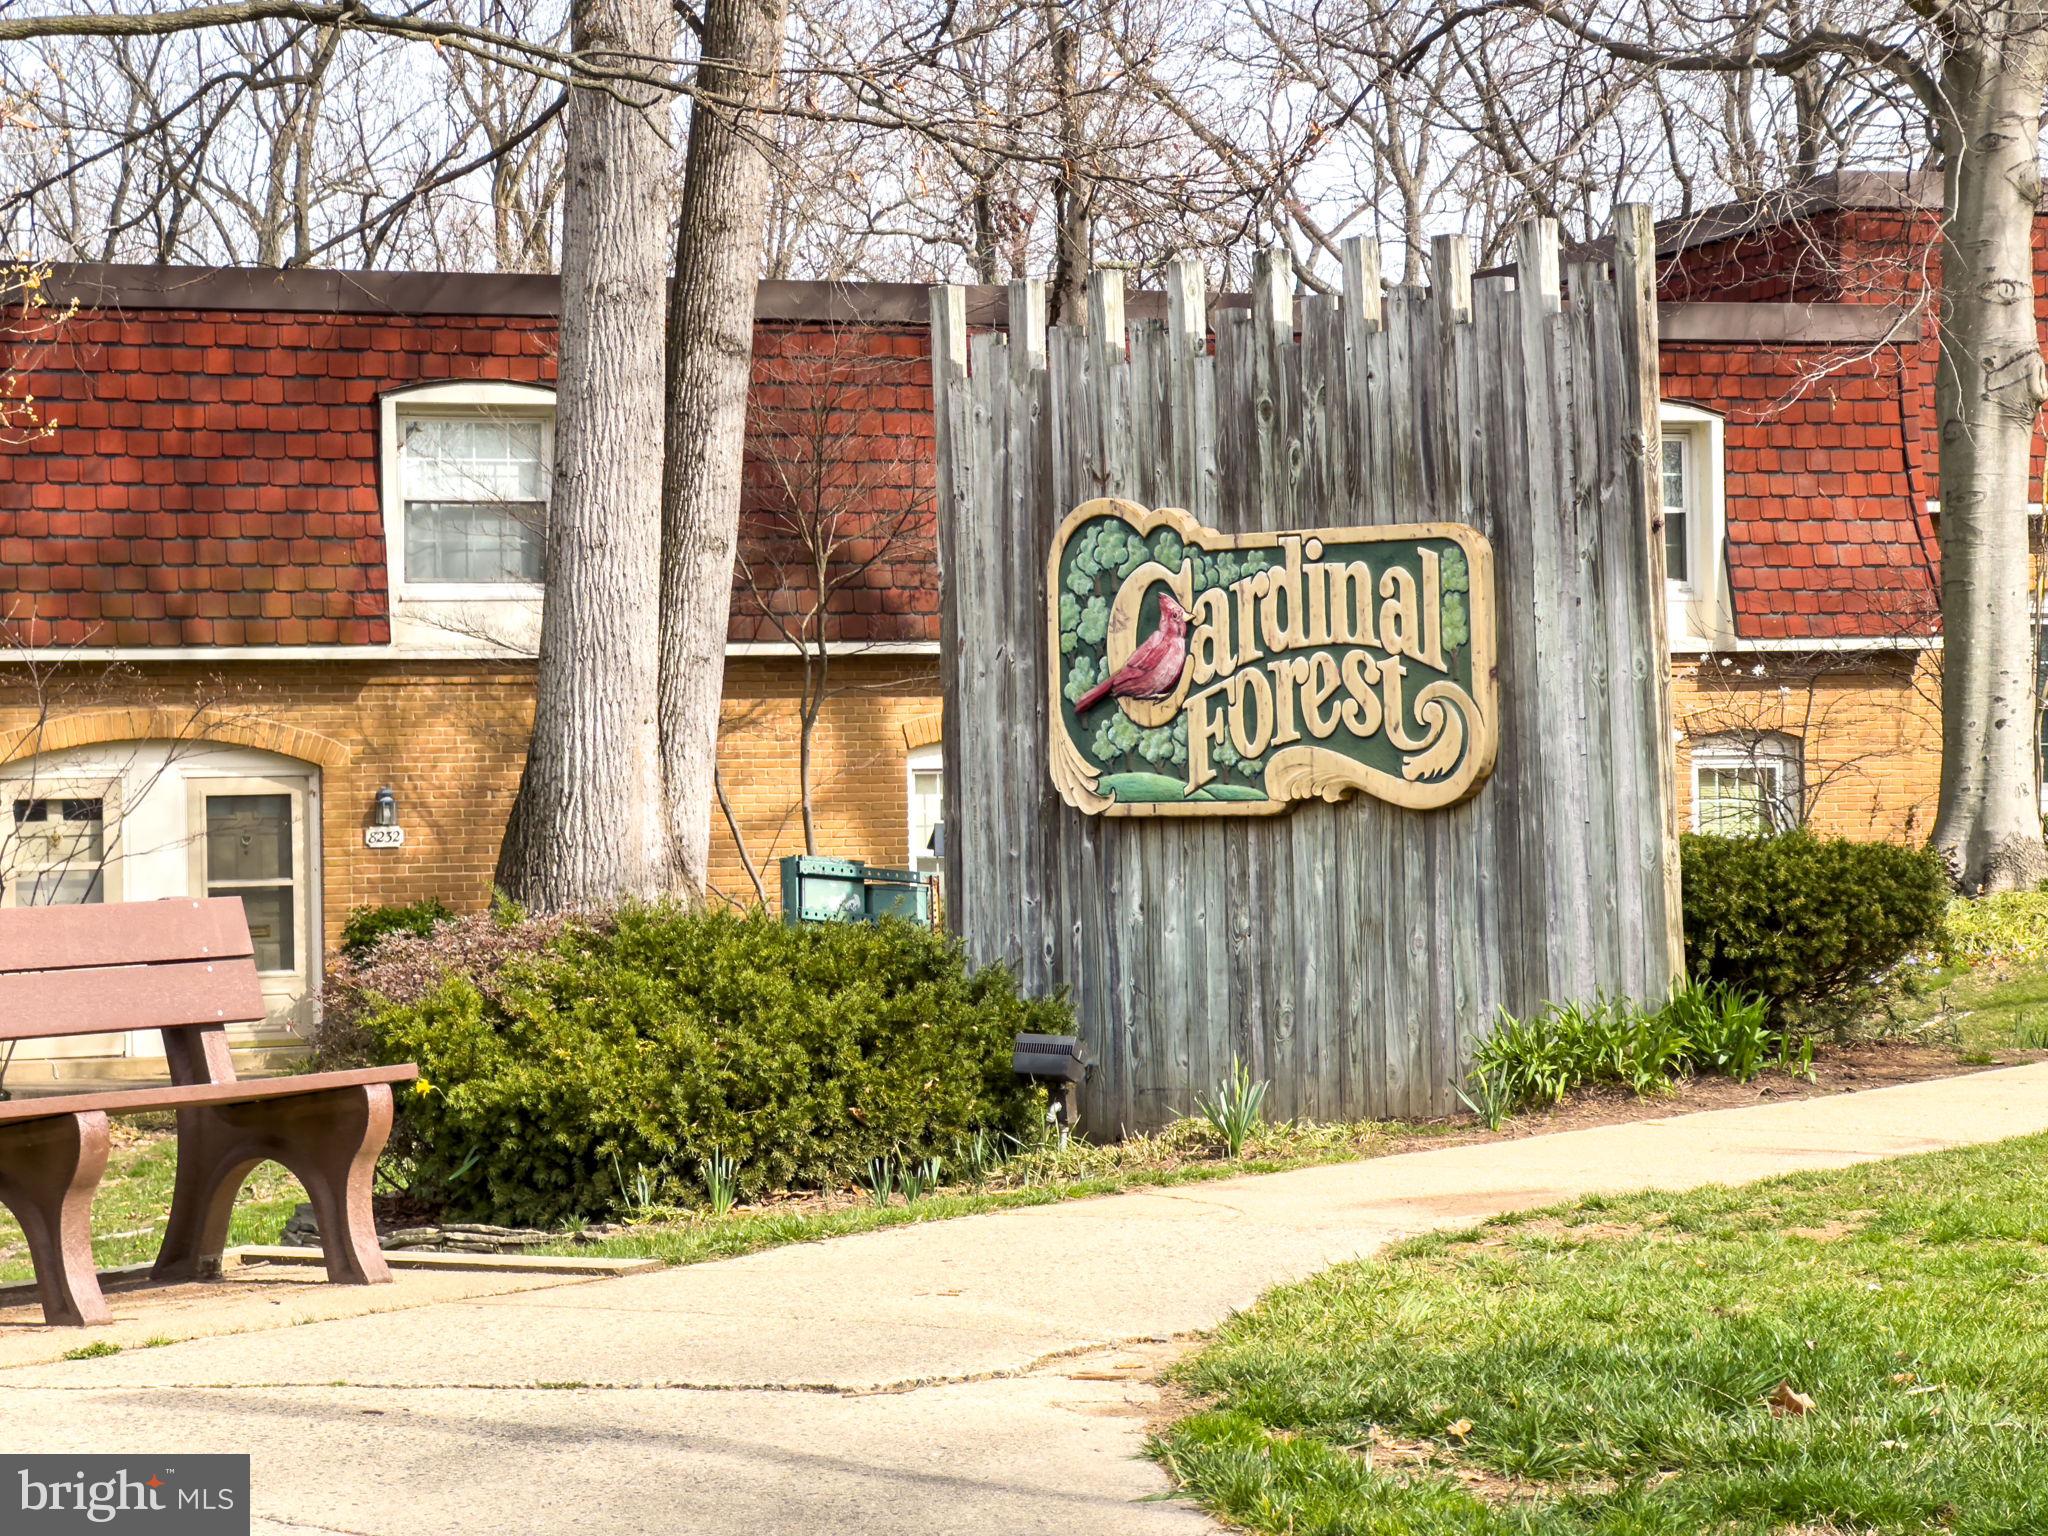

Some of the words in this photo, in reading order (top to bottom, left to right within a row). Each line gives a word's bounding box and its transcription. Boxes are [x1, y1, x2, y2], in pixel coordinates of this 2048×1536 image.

[1107, 535, 1448, 728] Cardinal
[1182, 649, 1444, 797] Forest
[368, 831, 400, 843] 8232
